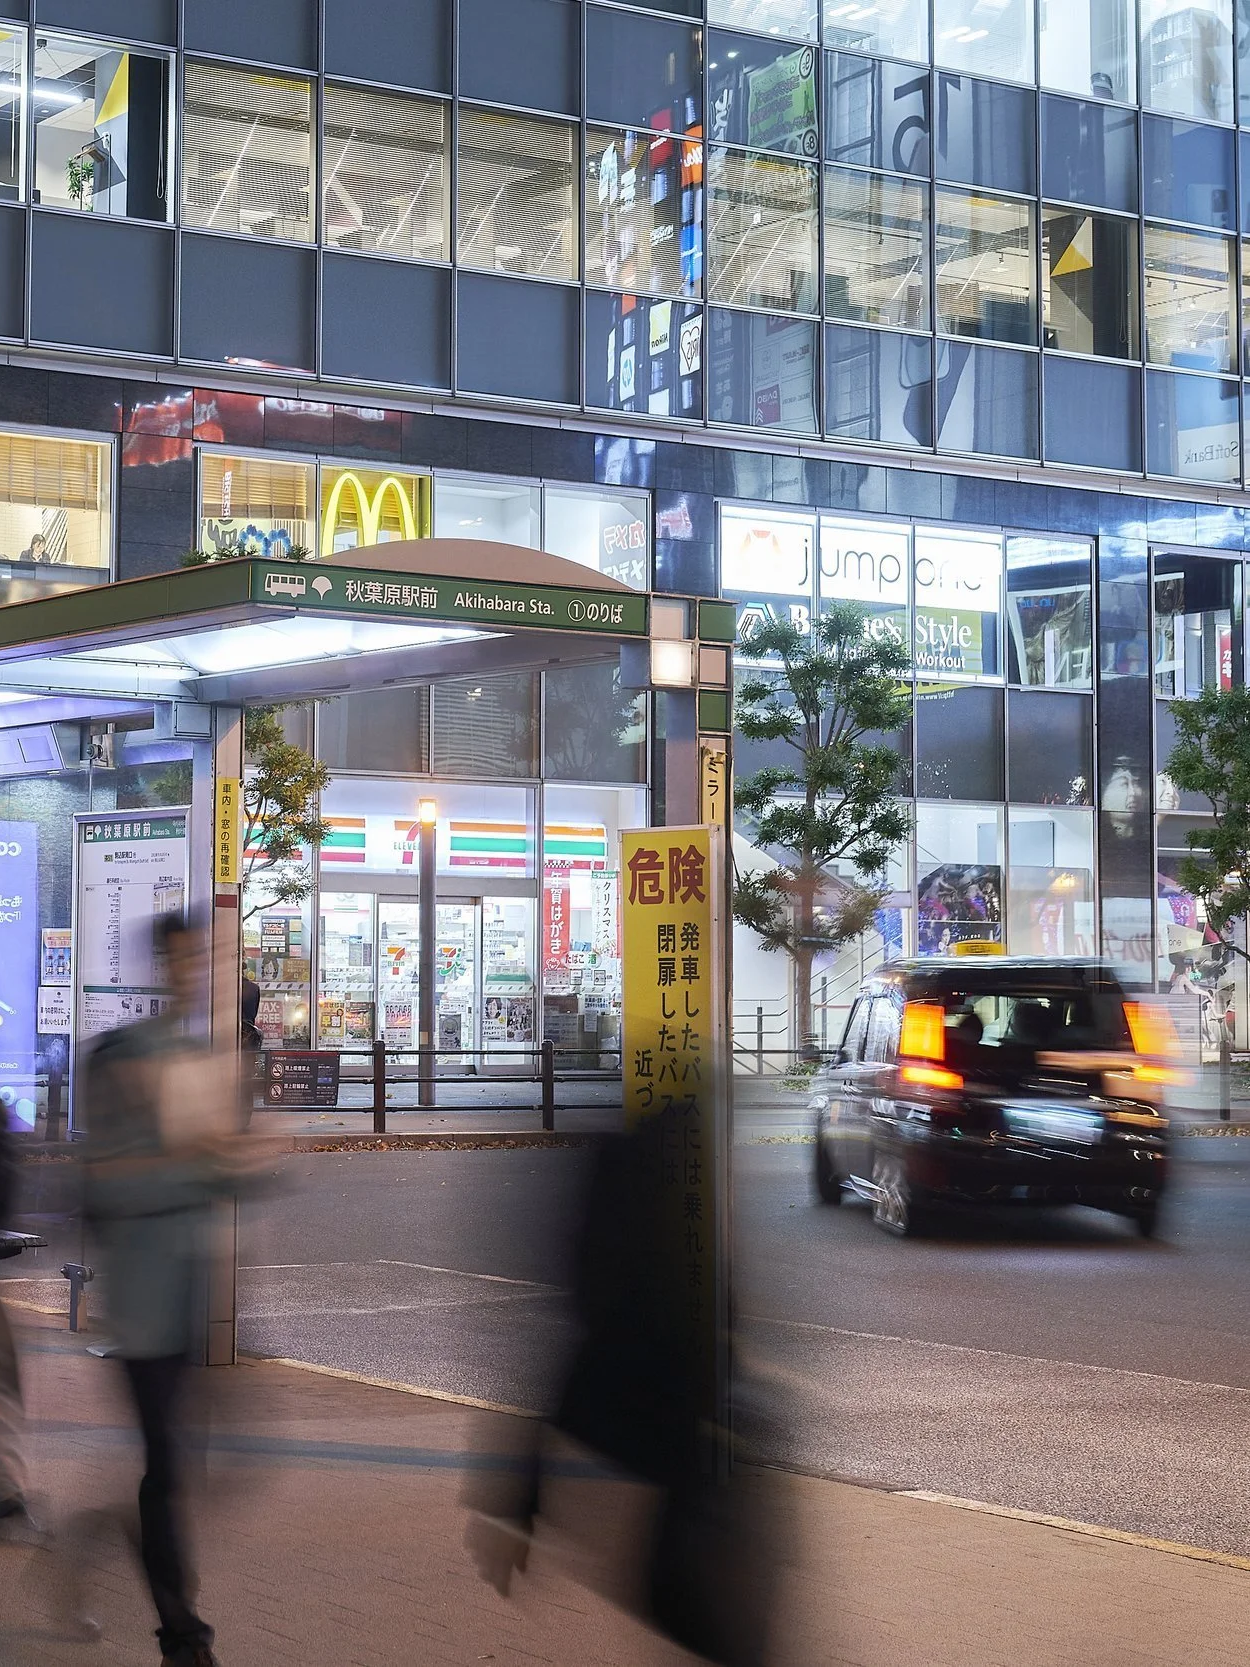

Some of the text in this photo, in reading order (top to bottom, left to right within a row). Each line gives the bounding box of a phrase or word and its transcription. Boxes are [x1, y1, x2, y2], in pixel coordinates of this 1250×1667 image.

[798, 538, 901, 593] jump
[345, 579, 438, 609] 秋葉原駅前
[454, 592, 526, 613] Akihabara
[530, 597, 555, 615] Sta.
[914, 614, 973, 651] Style
[915, 650, 967, 669] Workout
[103, 821, 151, 839] 秋葉原駅前
[220, 783, 232, 877] 車内・窓の再確認
[627, 843, 707, 908] 危険
[550, 871, 565, 955] 年賀はがき
[565, 953, 585, 964] たばこ
